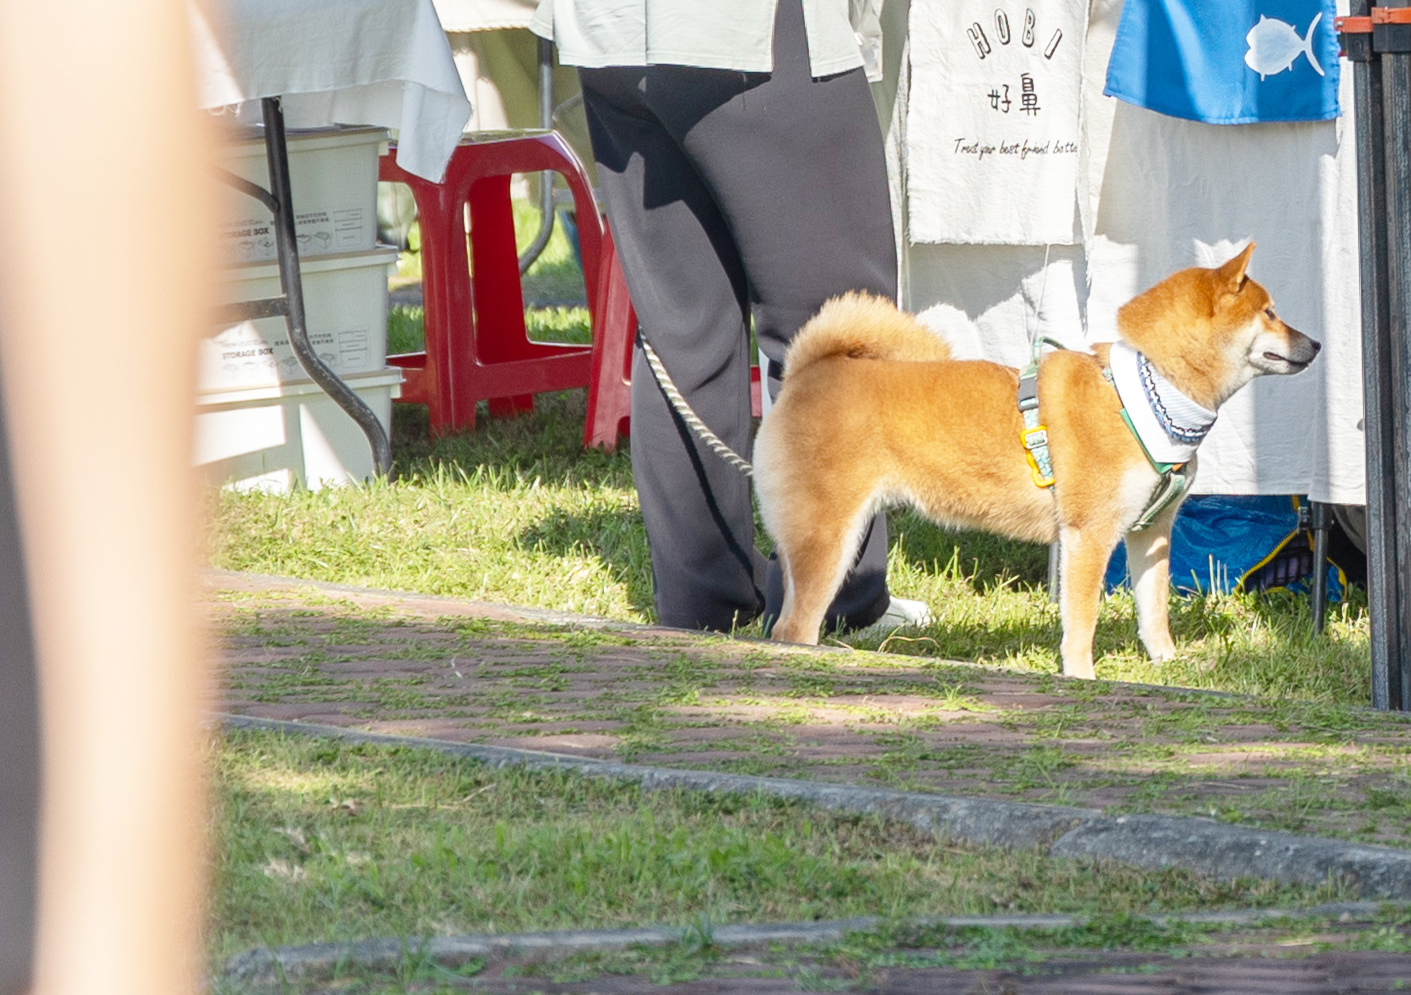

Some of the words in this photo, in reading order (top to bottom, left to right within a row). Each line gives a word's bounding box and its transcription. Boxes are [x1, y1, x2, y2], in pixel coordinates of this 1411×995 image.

[966, 7, 1063, 60] HOBI
[987, 72, 1042, 117] 好鼻
[999, 140, 1020, 154] best
[253, 227, 269, 236] BOX
[258, 347, 274, 356] BOX
